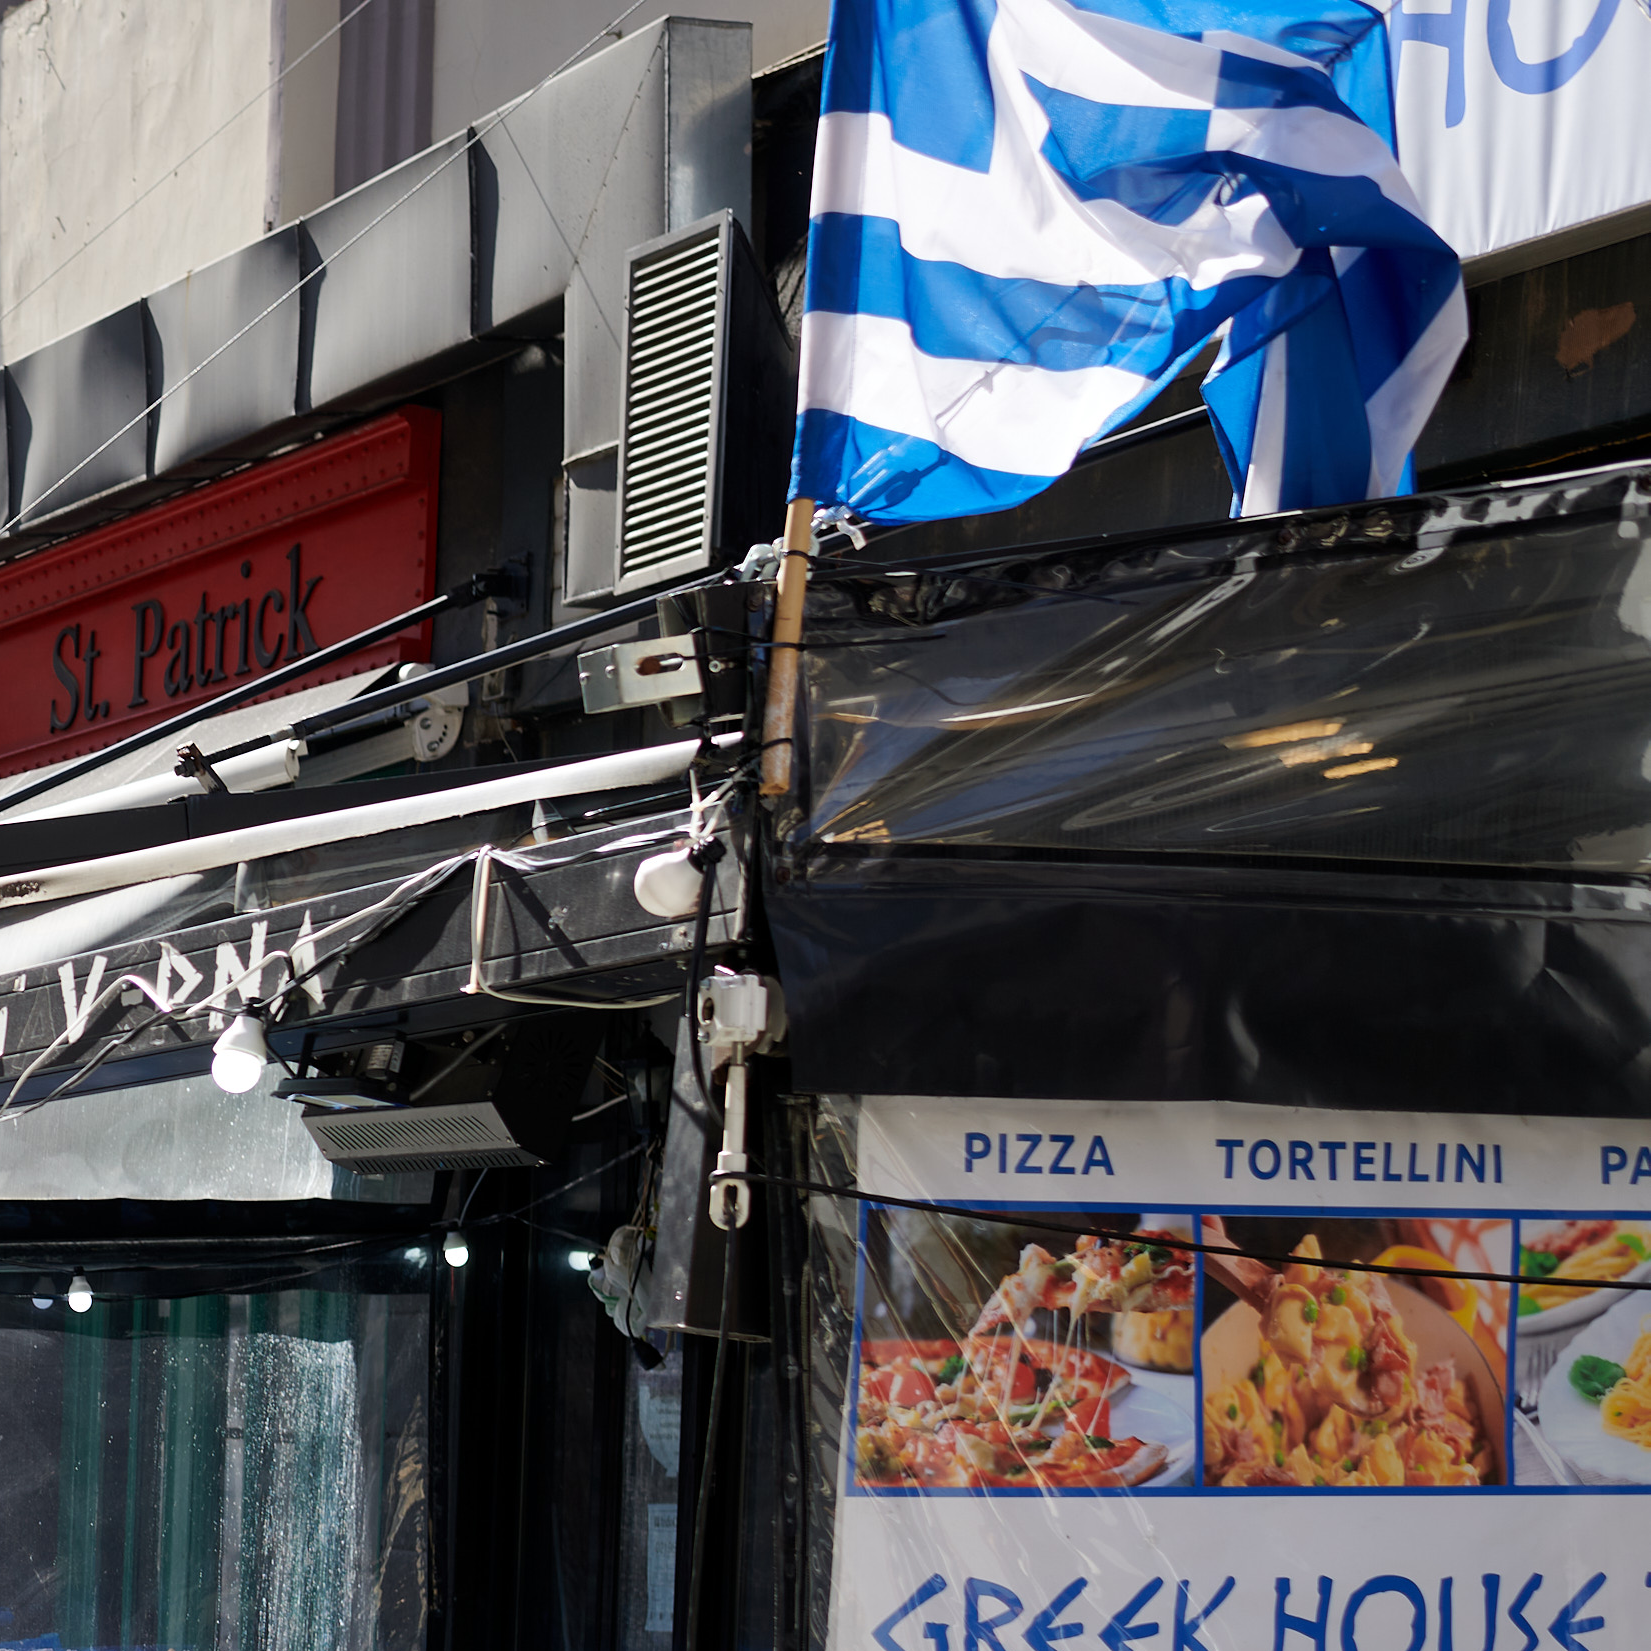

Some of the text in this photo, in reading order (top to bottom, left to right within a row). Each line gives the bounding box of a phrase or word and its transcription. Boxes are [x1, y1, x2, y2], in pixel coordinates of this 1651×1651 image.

[49, 542, 326, 734] St. Patrick
[963, 1131, 1651, 1186] PIZZA TORTELLINI PA
